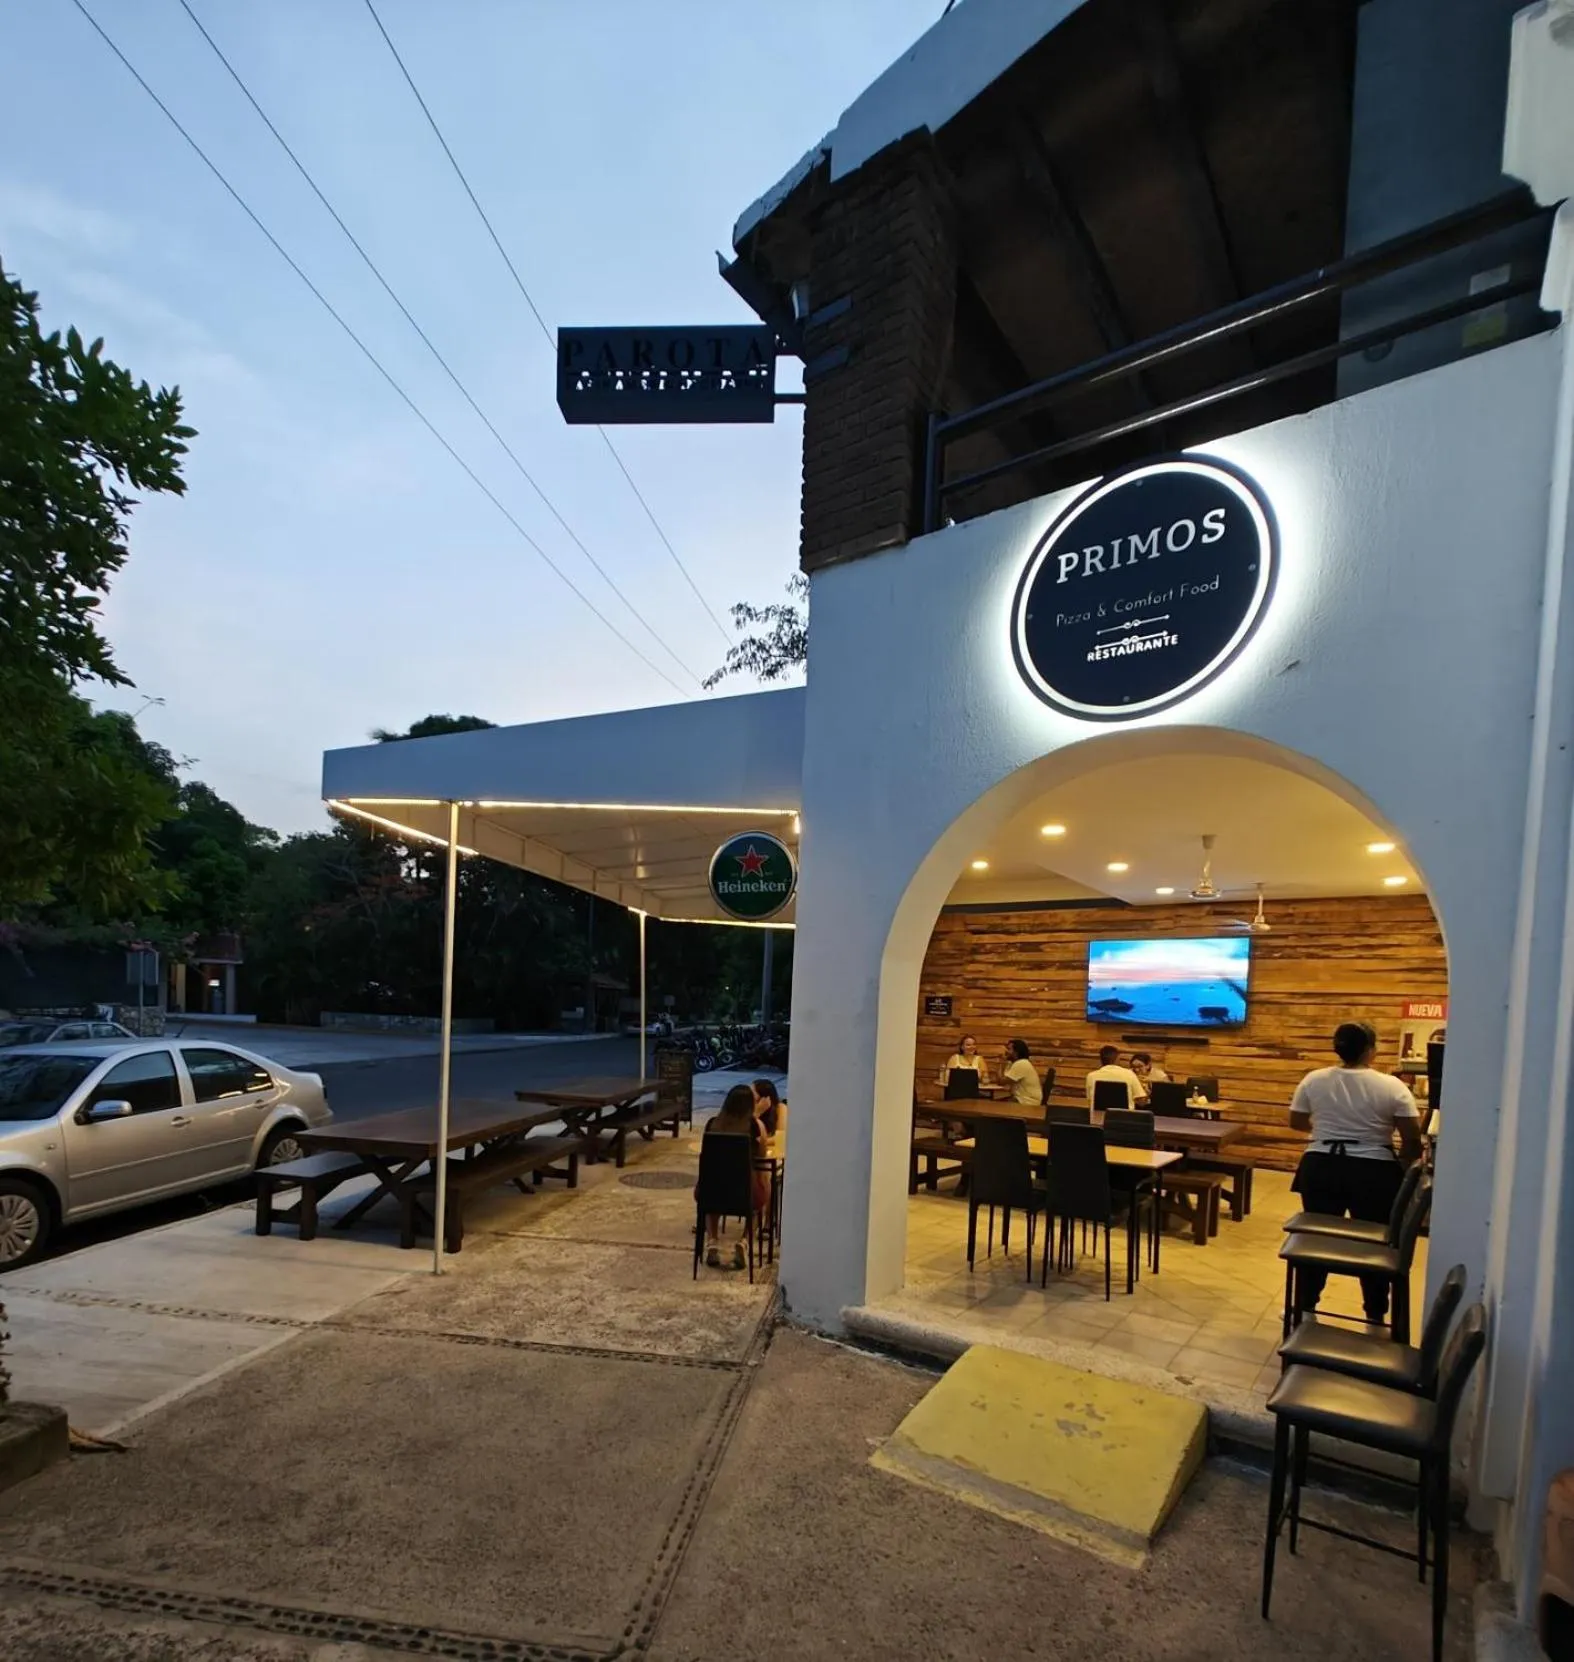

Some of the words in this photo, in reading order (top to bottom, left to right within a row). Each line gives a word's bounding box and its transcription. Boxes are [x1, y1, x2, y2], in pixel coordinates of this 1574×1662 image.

[562, 337, 767, 369] PAROTA
[1056, 508, 1226, 584] PRIMOS
[1056, 612, 1091, 627] Pizza
[1097, 604, 1106, 617] &
[1113, 589, 1173, 613] Comfort
[1180, 574, 1220, 598] Food
[1087, 634, 1178, 662] RESTAURANTE
[718, 880, 786, 893] Heineken
